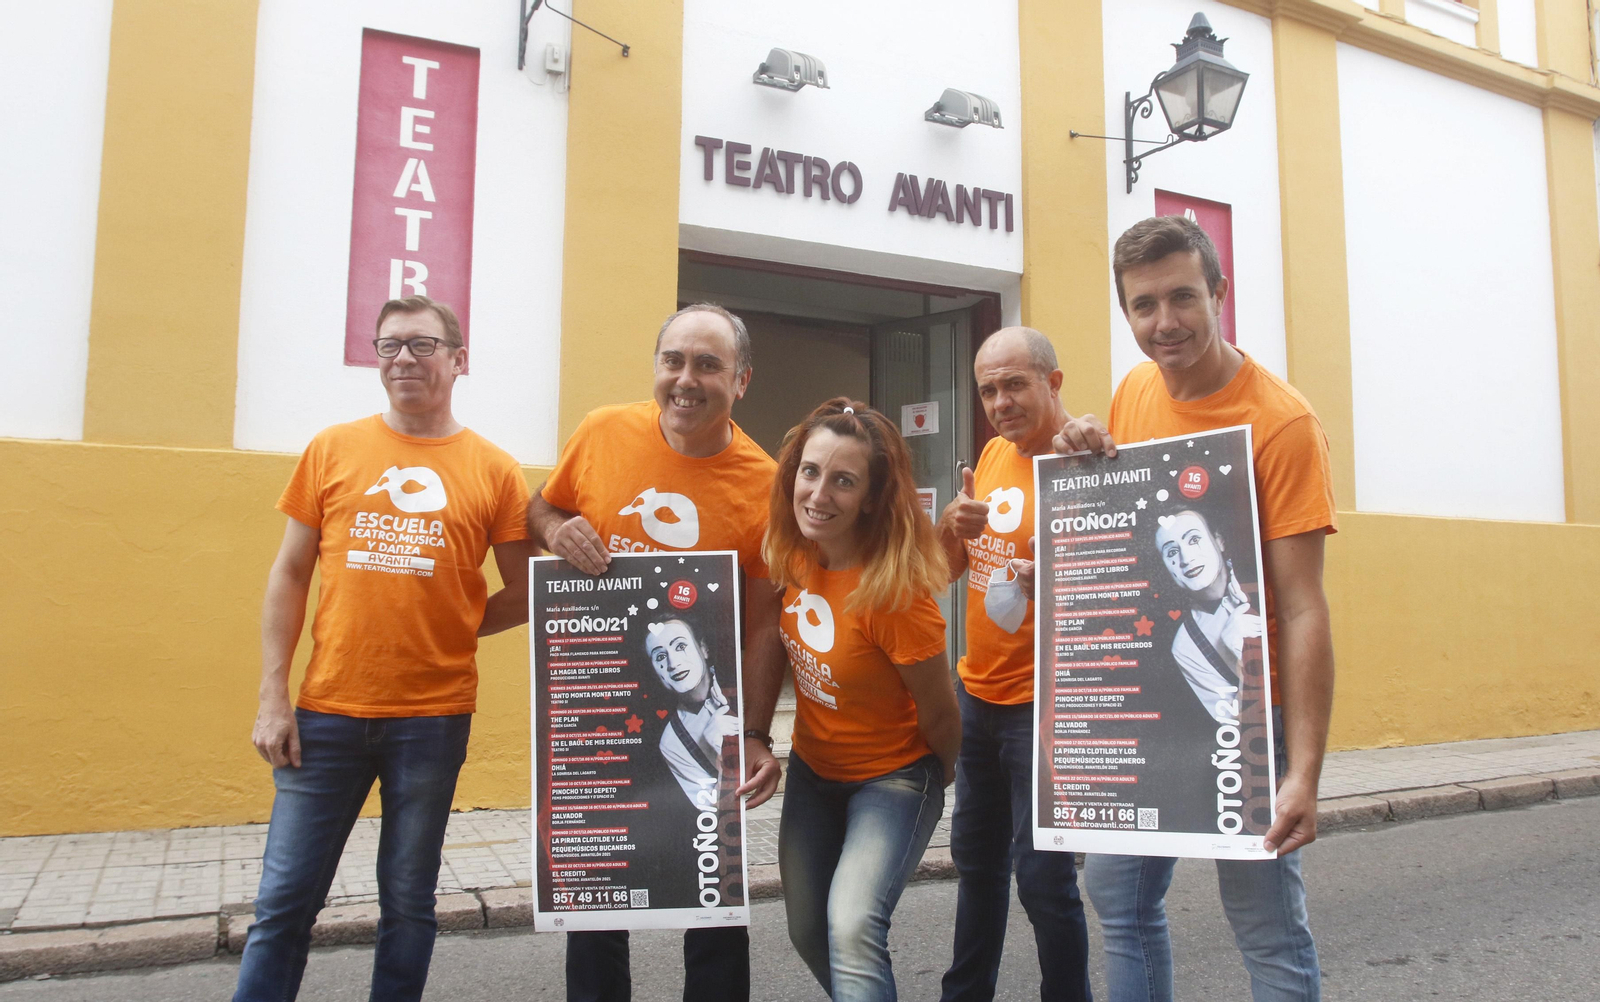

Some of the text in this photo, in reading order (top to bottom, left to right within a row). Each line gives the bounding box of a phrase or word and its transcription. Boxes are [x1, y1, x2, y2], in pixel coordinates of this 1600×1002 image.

[388, 55, 440, 301] TEATR
[694, 134, 1014, 233] TEATRO AVANTI
[1052, 468, 1150, 492] TEATRO AVANTI
[1188, 472, 1201, 483] 16
[355, 512, 443, 536] ESCUELA
[1051, 511, 1136, 533] OTOÑO/21
[367, 541, 420, 556] Y DANZA
[368, 554, 412, 566] AVANTI
[346, 562, 434, 578] WWW.TEATROAVANTI.COM
[546, 577, 642, 593] TEATRO AVANTI
[678, 585, 690, 596] 16
[545, 615, 628, 634] OTOÑO/21
[1211, 685, 1243, 836] OTOÑO/21
[1054, 807, 1134, 821] 957 49 11 66
[693, 776, 720, 908] OTOÑO/21
[553, 891, 627, 903] 957 49 11 66
